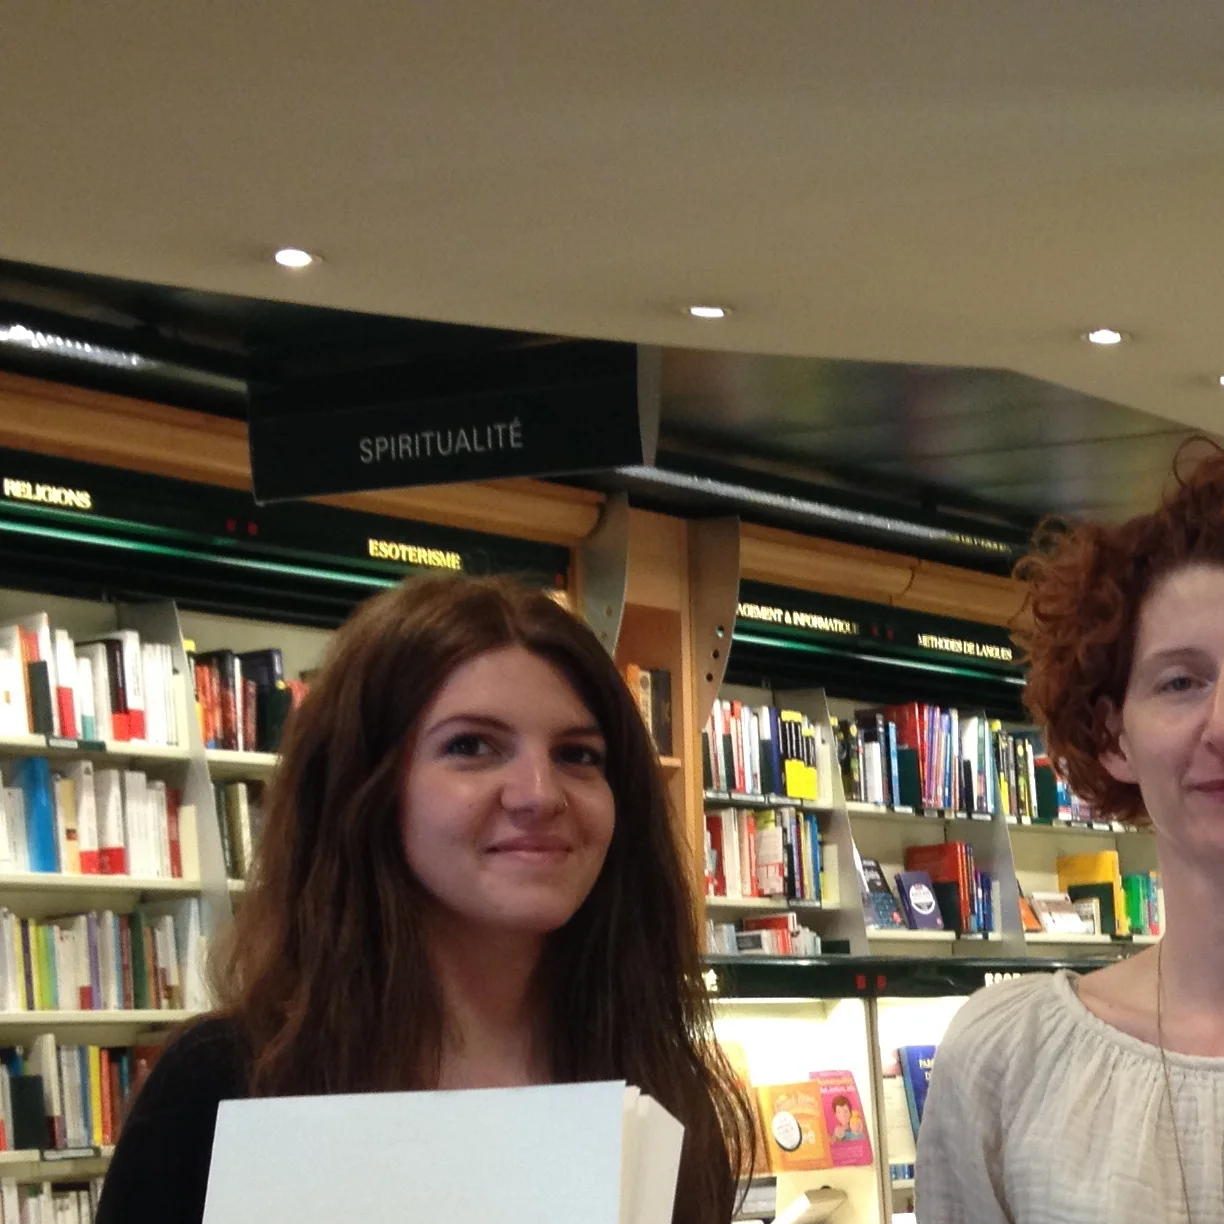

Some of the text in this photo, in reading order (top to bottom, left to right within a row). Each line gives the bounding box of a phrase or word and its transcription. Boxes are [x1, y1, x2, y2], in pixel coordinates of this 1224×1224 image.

[359, 416, 524, 464] SPIRITUALITÉ
[3, 477, 92, 509] RELIGIONS
[368, 538, 462, 570] ESOTERISME
